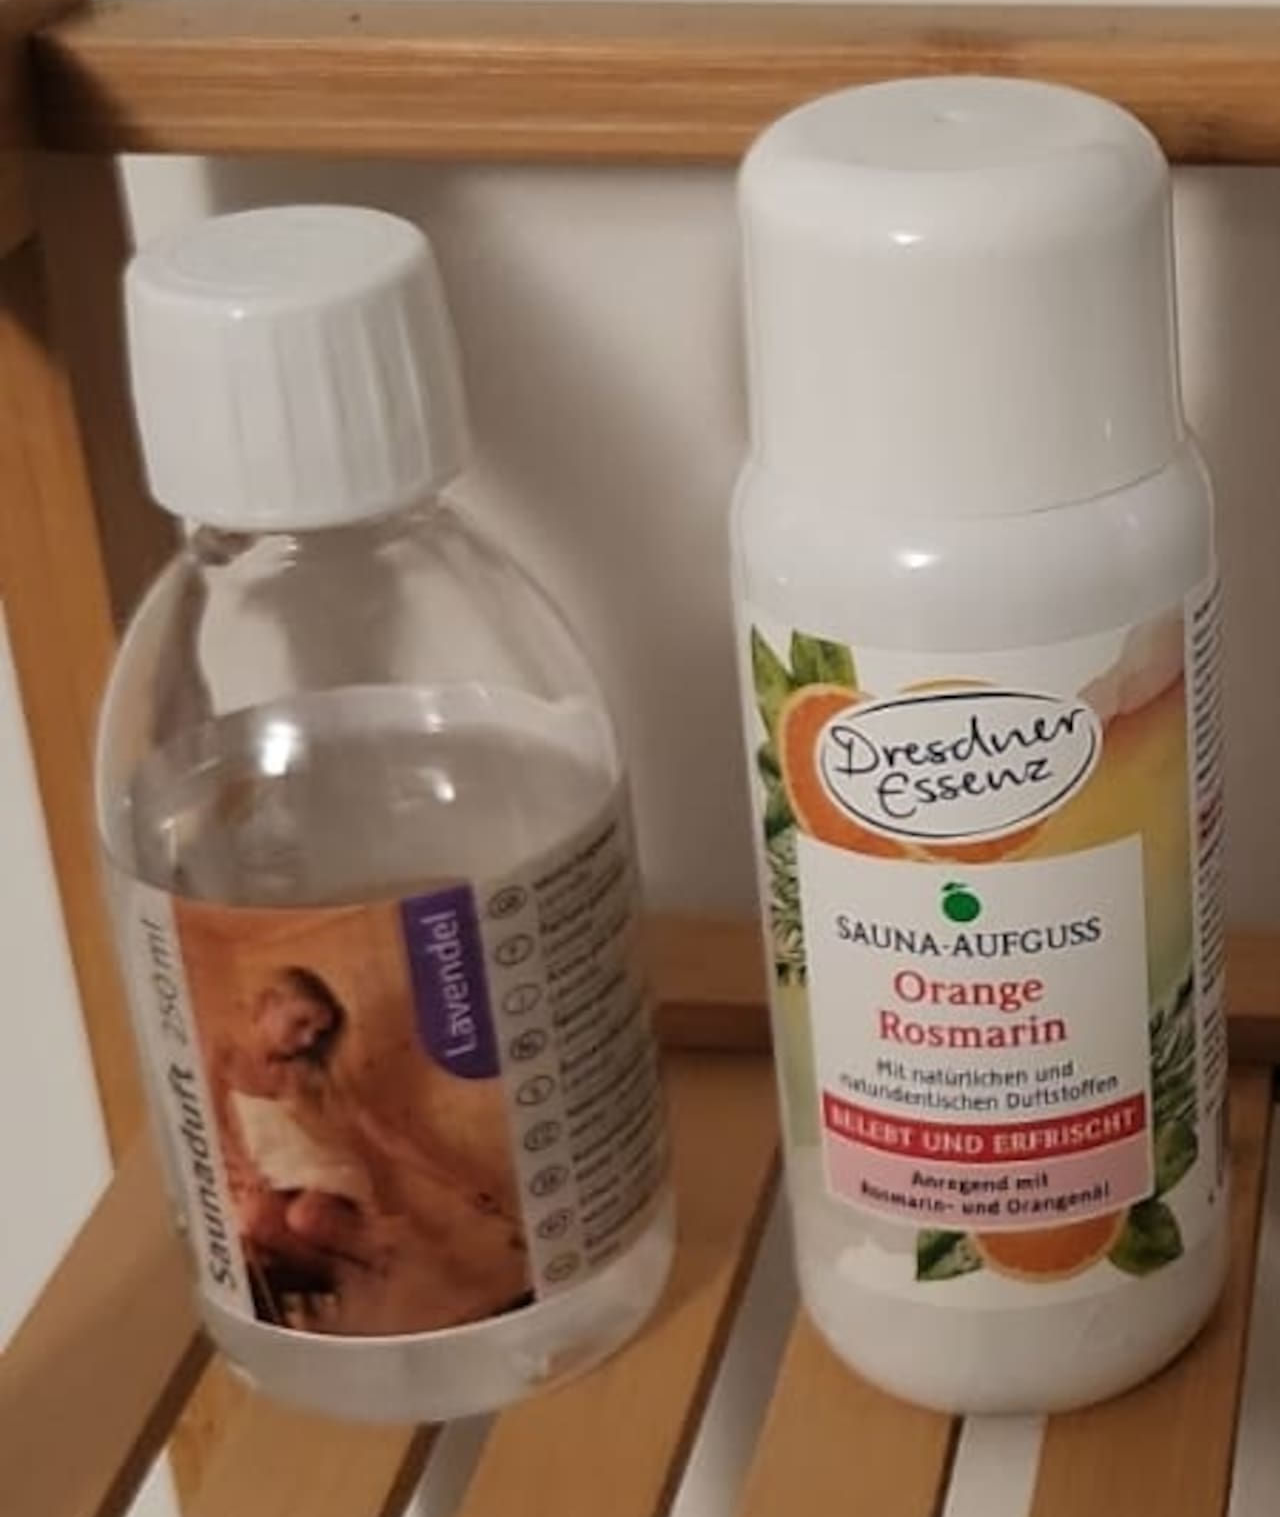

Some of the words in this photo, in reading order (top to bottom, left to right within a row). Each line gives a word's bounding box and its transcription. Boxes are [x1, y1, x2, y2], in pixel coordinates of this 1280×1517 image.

[829, 707, 1086, 776] Dresdner
[876, 757, 1054, 820] Essenz
[835, 916, 1102, 959] SAUNA-AUFGUSS
[420, 908, 476, 1059] Lavendel
[893, 970, 1045, 1013] Orange
[878, 1010, 1068, 1049] Rosmarin
[876, 1058, 906, 1080] Mit
[911, 1062, 1029, 1087] natürlichen
[1034, 1059, 1075, 1081] und
[1006, 1075, 1119, 1110] Duftstoffen
[923, 1132, 985, 1155] UND
[992, 1107, 1138, 1154] ERFRISCHT
[166, 1062, 237, 1292] Saunaduft
[911, 1170, 1010, 1195] Anregend
[1015, 1171, 1049, 1192] mit
[961, 1194, 1001, 1216] und
